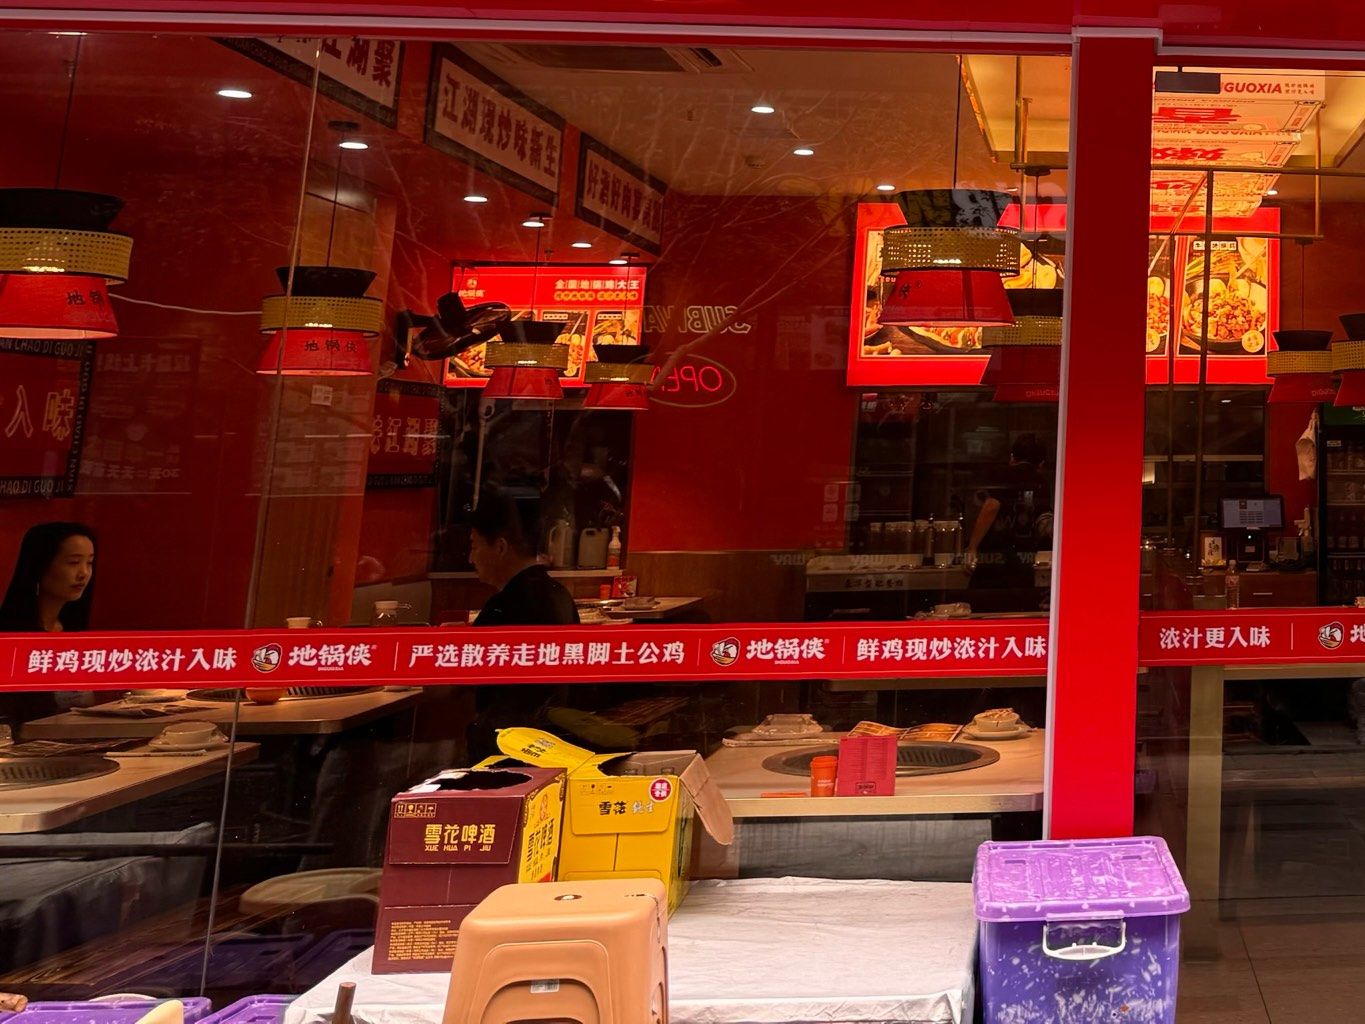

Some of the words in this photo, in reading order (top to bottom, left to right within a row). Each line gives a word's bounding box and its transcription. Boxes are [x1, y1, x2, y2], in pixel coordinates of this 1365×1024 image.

[1221, 82, 1283, 94] GUOXIA
[1160, 625, 1271, 650] 浓汁更入味
[28, 647, 237, 674] 鲜鸡现炒浓汁入味
[288, 643, 373, 666] 地锅侠
[409, 641, 685, 668] 严选散养走地黑脚土公鸡
[746, 637, 826, 660] 地锅侠
[856, 636, 1046, 663] 鲜鸡现炒浓汁入味
[599, 801, 627, 816] 雪花
[424, 824, 496, 845] 雪花啤酒
